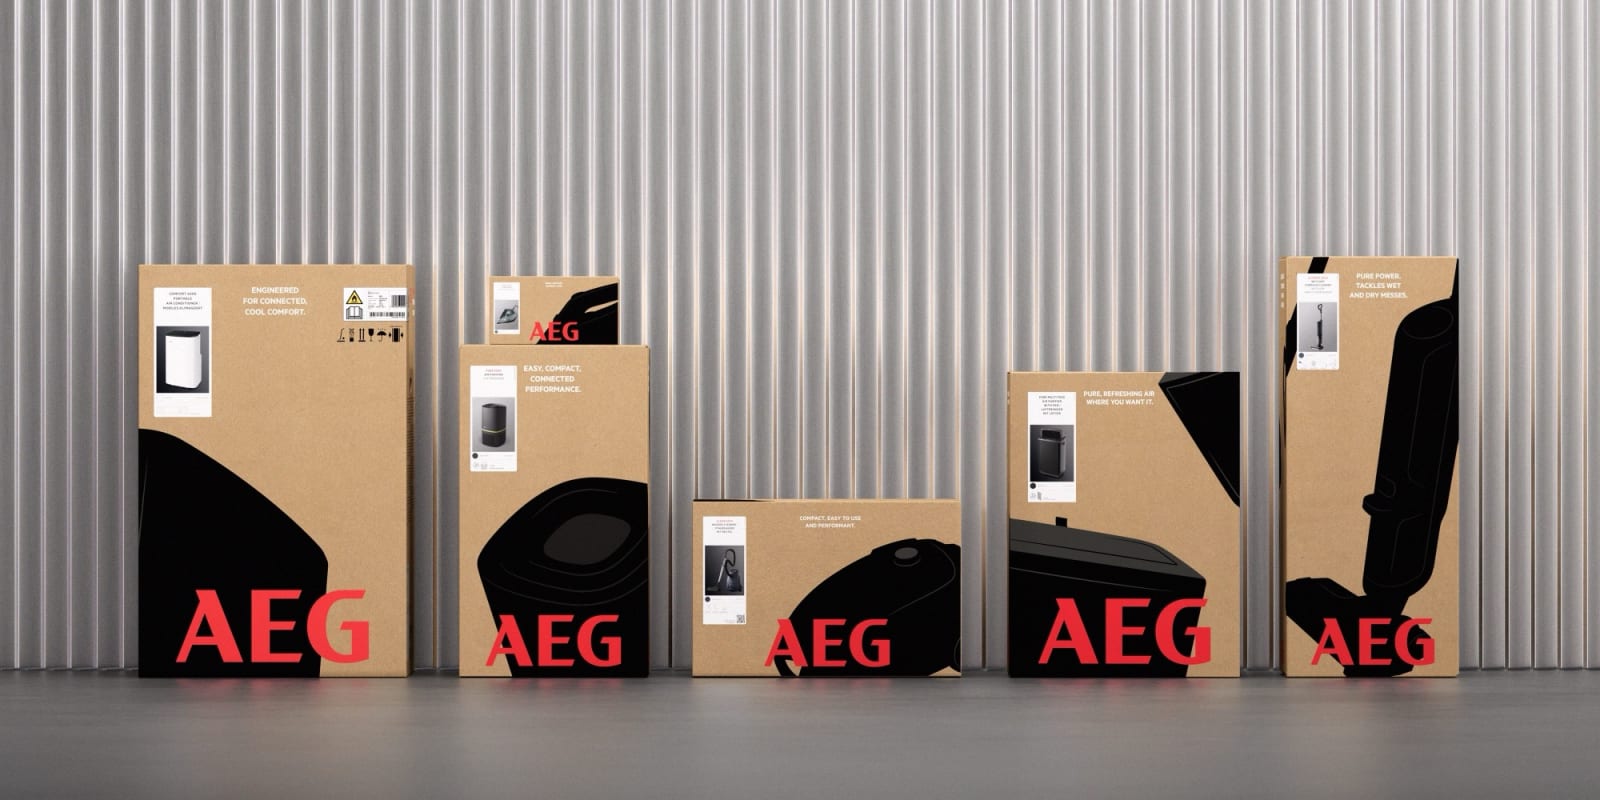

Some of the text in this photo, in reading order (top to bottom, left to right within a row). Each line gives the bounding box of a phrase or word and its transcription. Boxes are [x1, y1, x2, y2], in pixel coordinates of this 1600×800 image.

[251, 286, 300, 294] ENGINEERED
[242, 297, 259, 305] FOR
[245, 308, 306, 316] COOL COMFORT.
[531, 322, 579, 341] AEG
[530, 375, 575, 383] CONNECTED
[525, 385, 582, 393] PERFORMANCE.
[177, 589, 370, 664] AEG
[1038, 597, 1212, 666] AEG
[486, 615, 622, 667] AEG
[764, 619, 890, 668] AEG
[1311, 618, 1436, 666] AEG
